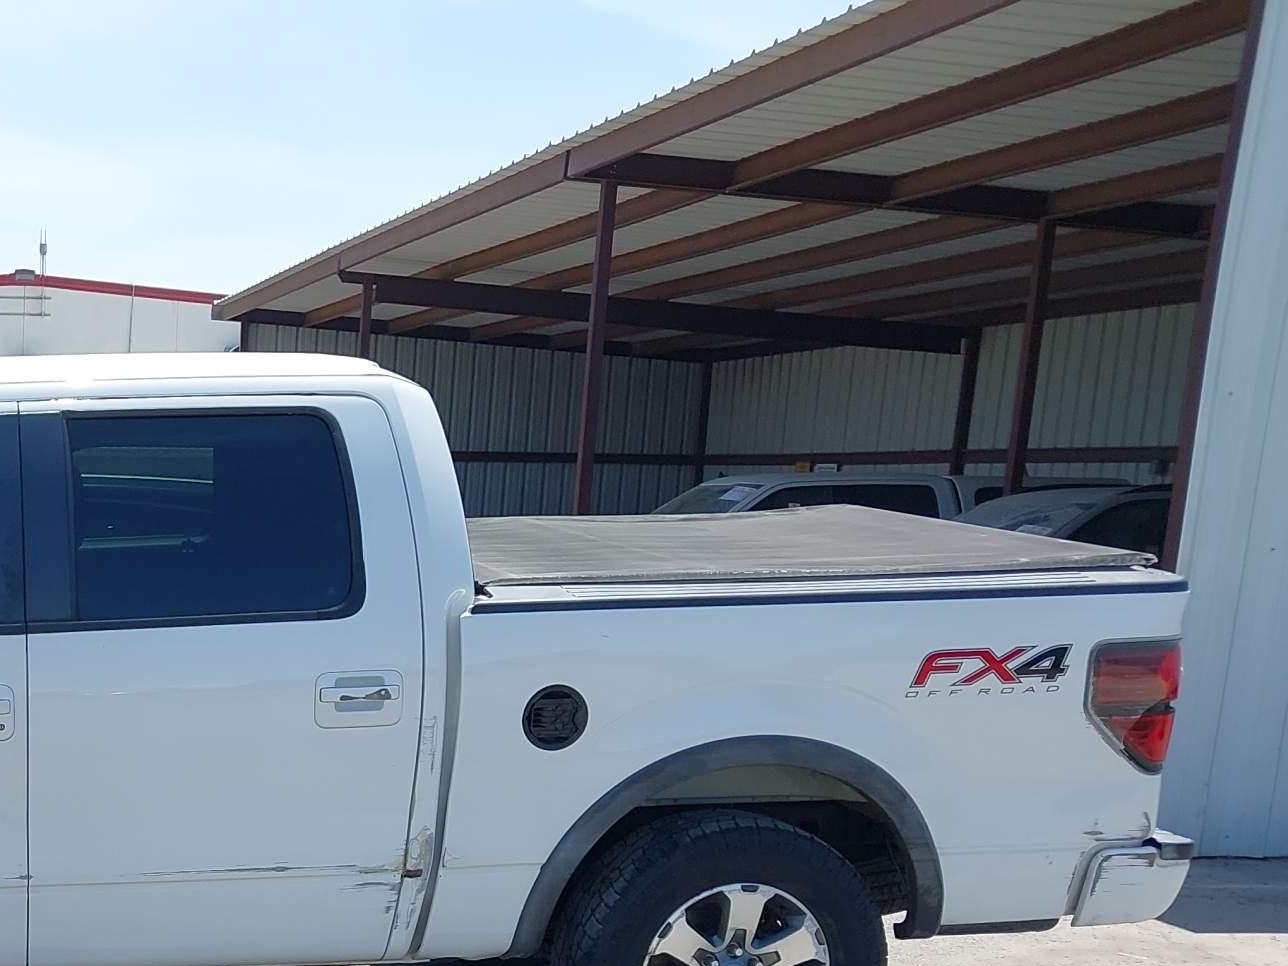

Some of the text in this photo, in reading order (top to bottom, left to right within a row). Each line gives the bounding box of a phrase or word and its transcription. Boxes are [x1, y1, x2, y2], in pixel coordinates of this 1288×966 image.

[909, 643, 1074, 688] FX4
[904, 685, 1060, 698] OFF ROAD
